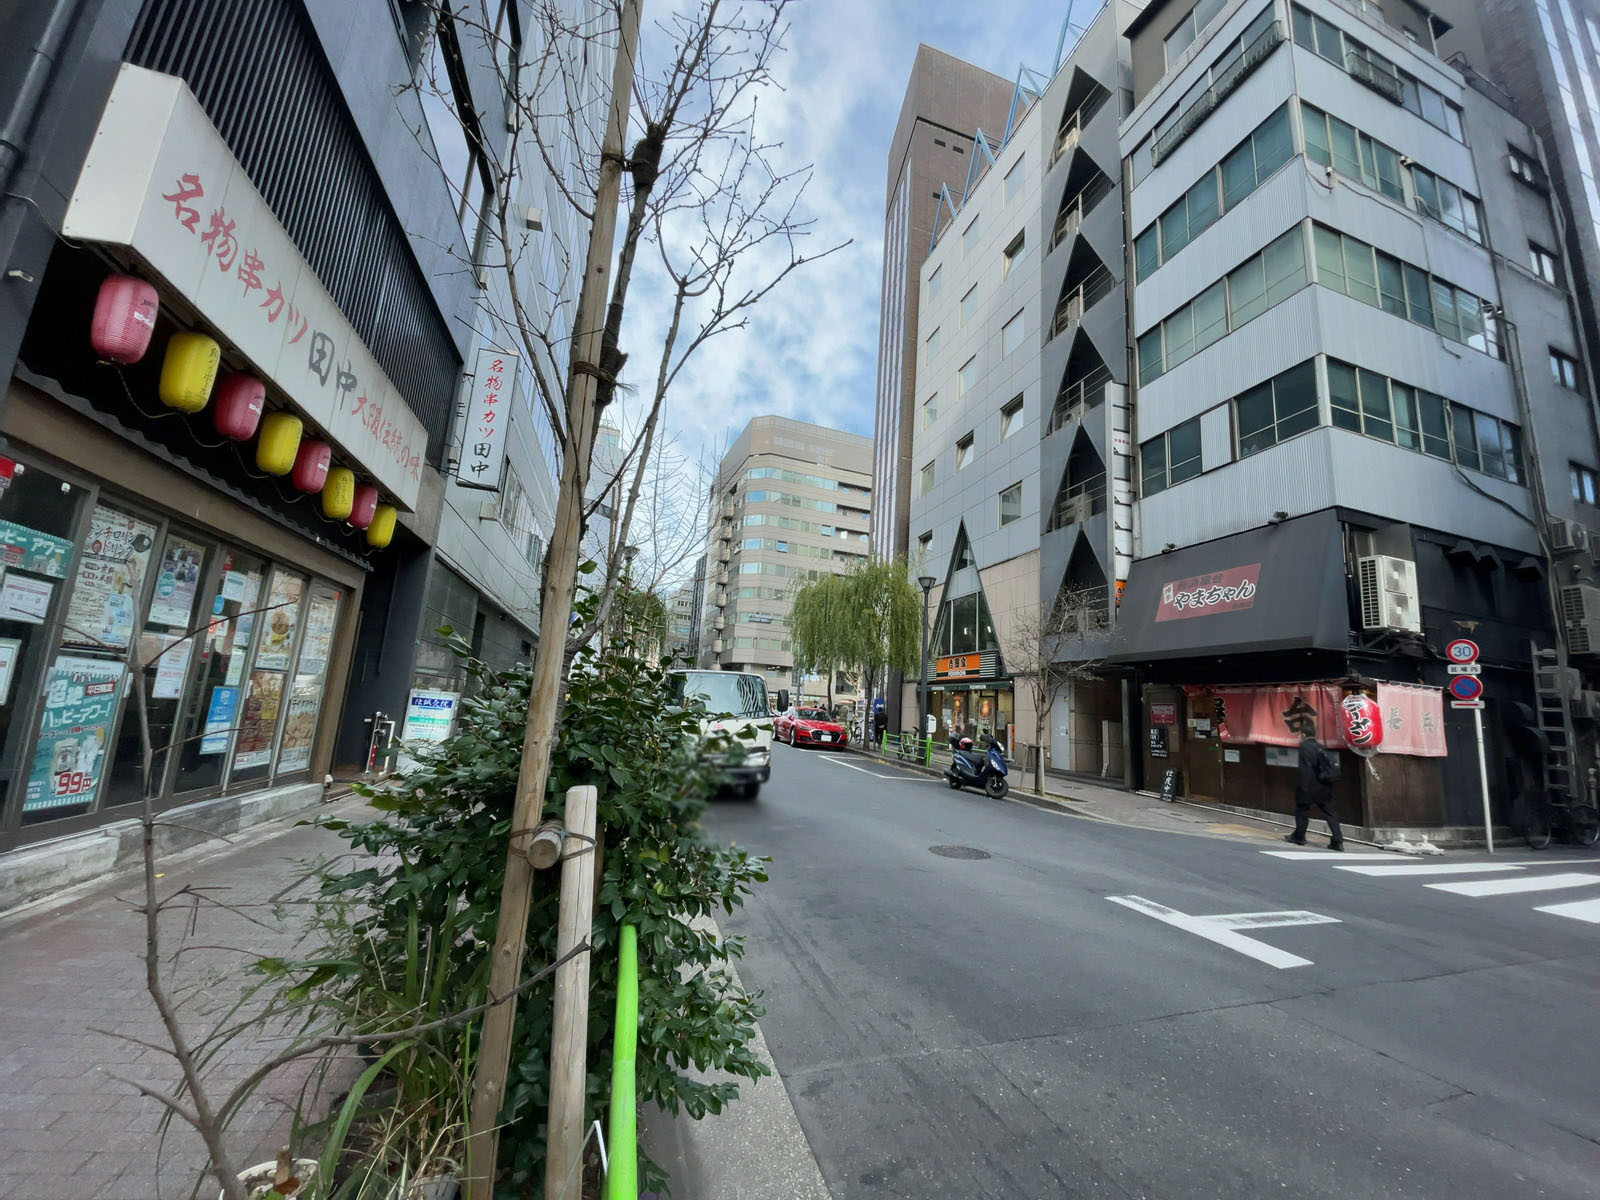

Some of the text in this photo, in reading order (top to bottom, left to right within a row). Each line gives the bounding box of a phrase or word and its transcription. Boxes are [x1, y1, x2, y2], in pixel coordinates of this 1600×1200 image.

[470, 359, 504, 478] 名物串カツ田中
[1173, 579, 1256, 610] やまちゃん
[1453, 646, 1472, 657] 30
[1344, 700, 1373, 744] ラーメン
